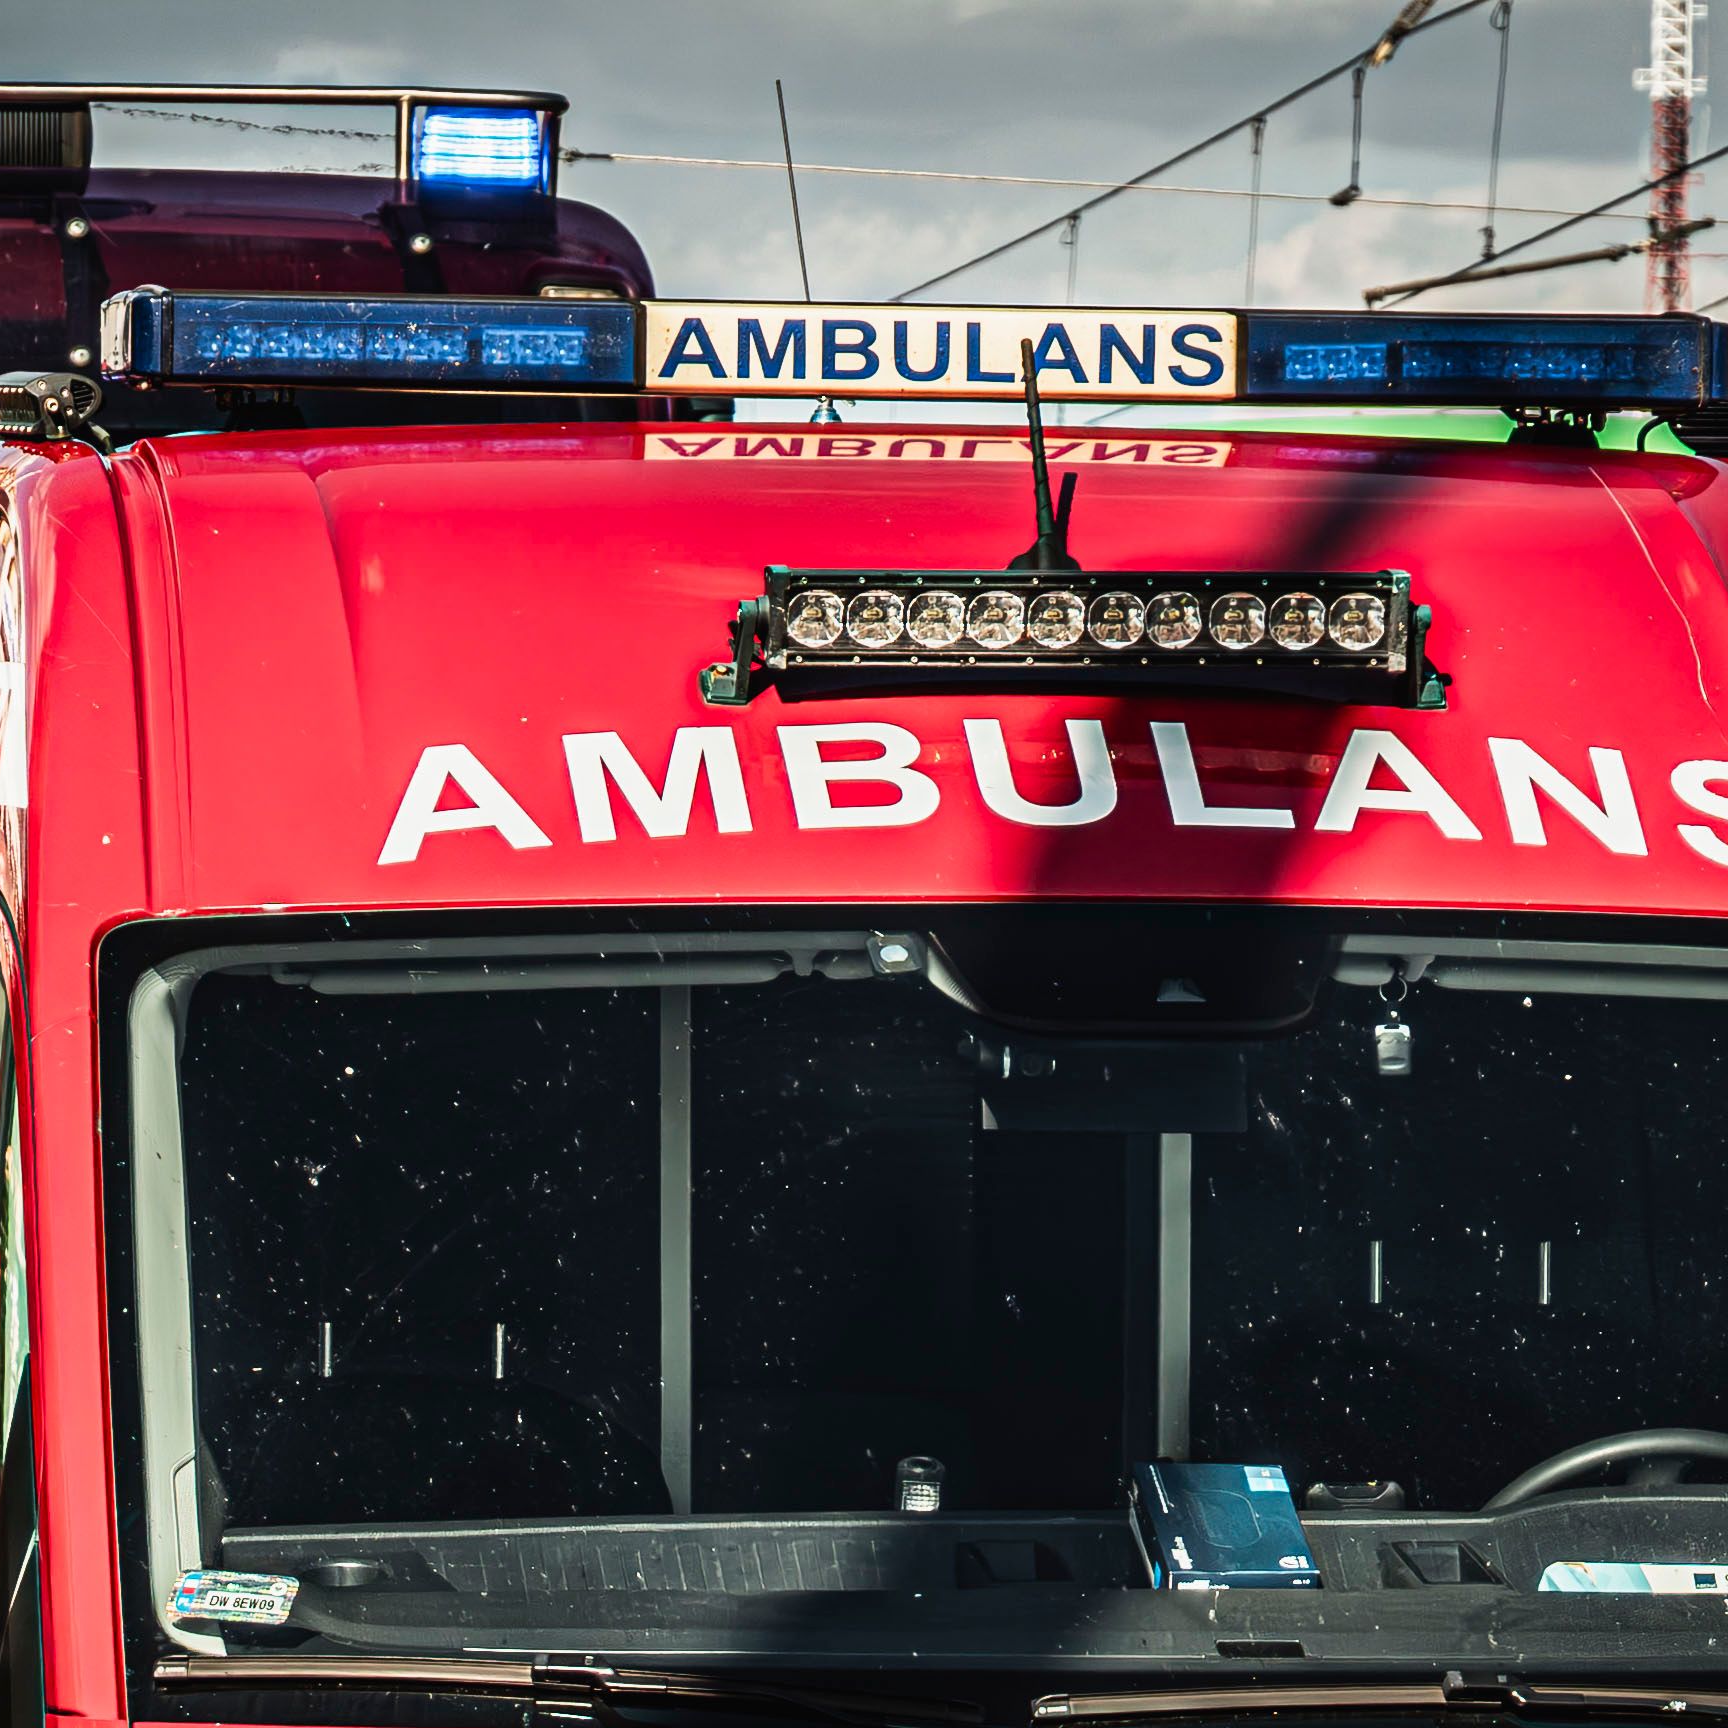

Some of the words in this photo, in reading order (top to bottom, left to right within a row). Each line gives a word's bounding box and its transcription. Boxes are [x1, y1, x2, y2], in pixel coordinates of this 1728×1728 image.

[658, 317, 1224, 386] AMBULANS
[209, 1595, 230, 1607] DW
[232, 1597, 275, 1611] 8EW09
